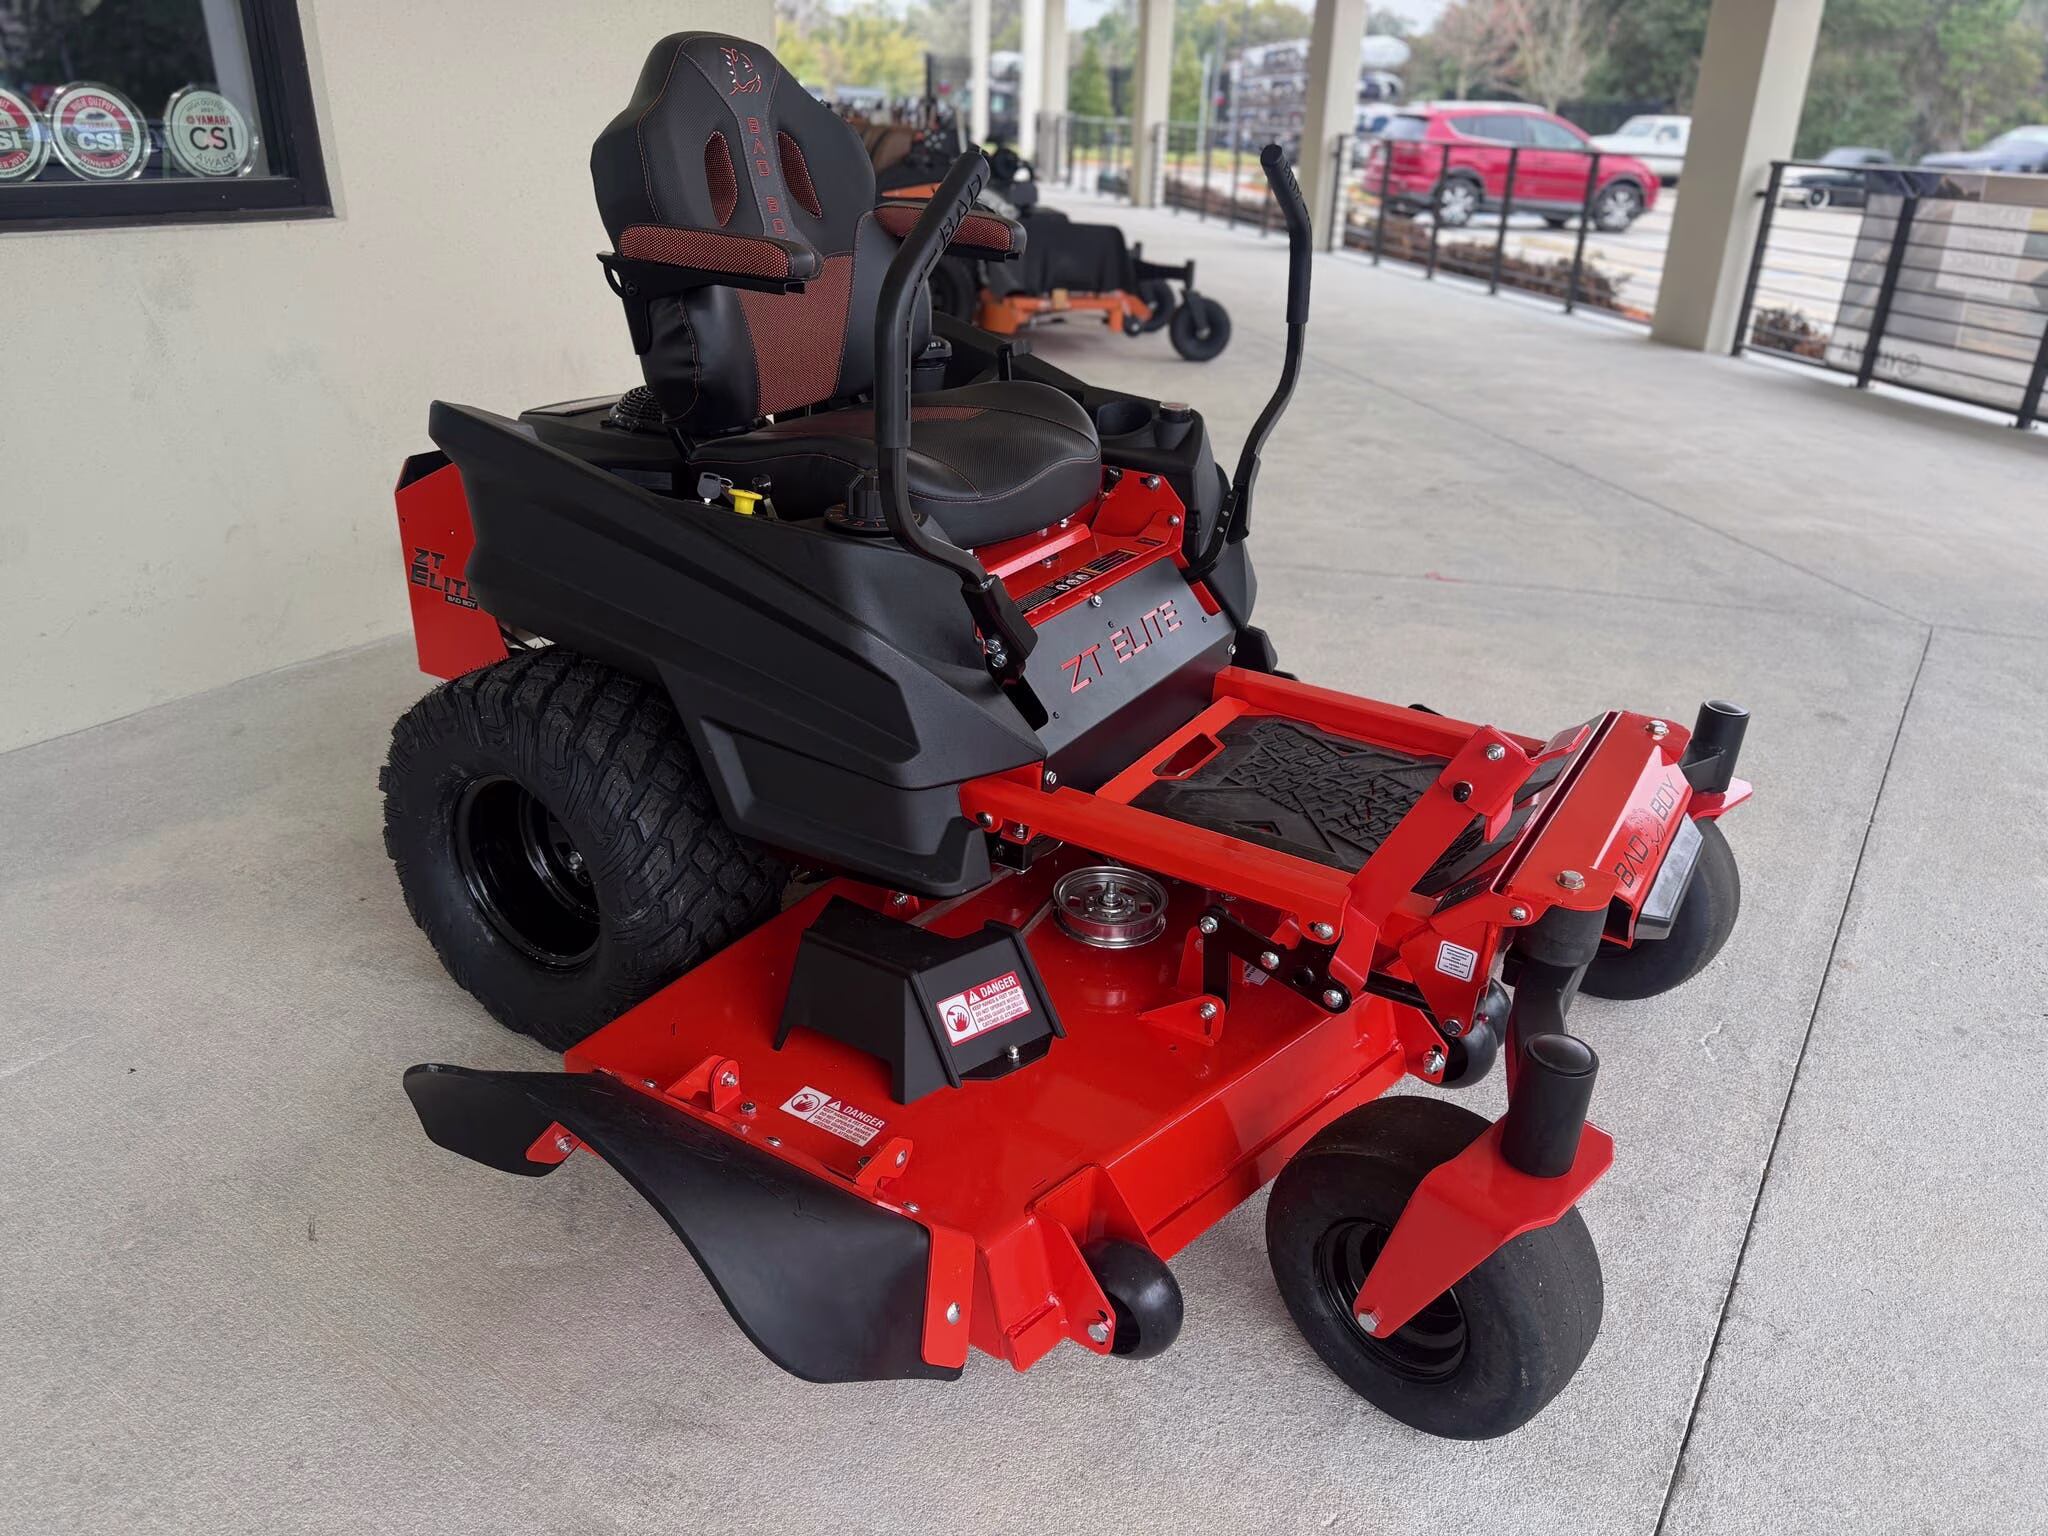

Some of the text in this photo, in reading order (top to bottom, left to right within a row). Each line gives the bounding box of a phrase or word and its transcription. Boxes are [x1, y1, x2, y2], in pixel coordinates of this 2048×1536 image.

[88, 97, 116, 112] OUTPUT
[196, 115, 232, 125] YAMAHA
[0, 131, 22, 150] SI
[77, 132, 124, 150] CSI
[190, 127, 236, 150] CSI
[746, 117, 770, 177] BAD
[81, 154, 111, 168] WINNER
[196, 152, 236, 166] AWARD
[766, 196, 788, 237] BO
[414, 547, 446, 569] ZT
[1061, 600, 1183, 694] ZT ELITE
[1614, 774, 1680, 889] BAD BOY
[980, 975, 1016, 998] DANGER
[842, 1106, 885, 1128] DANGER
